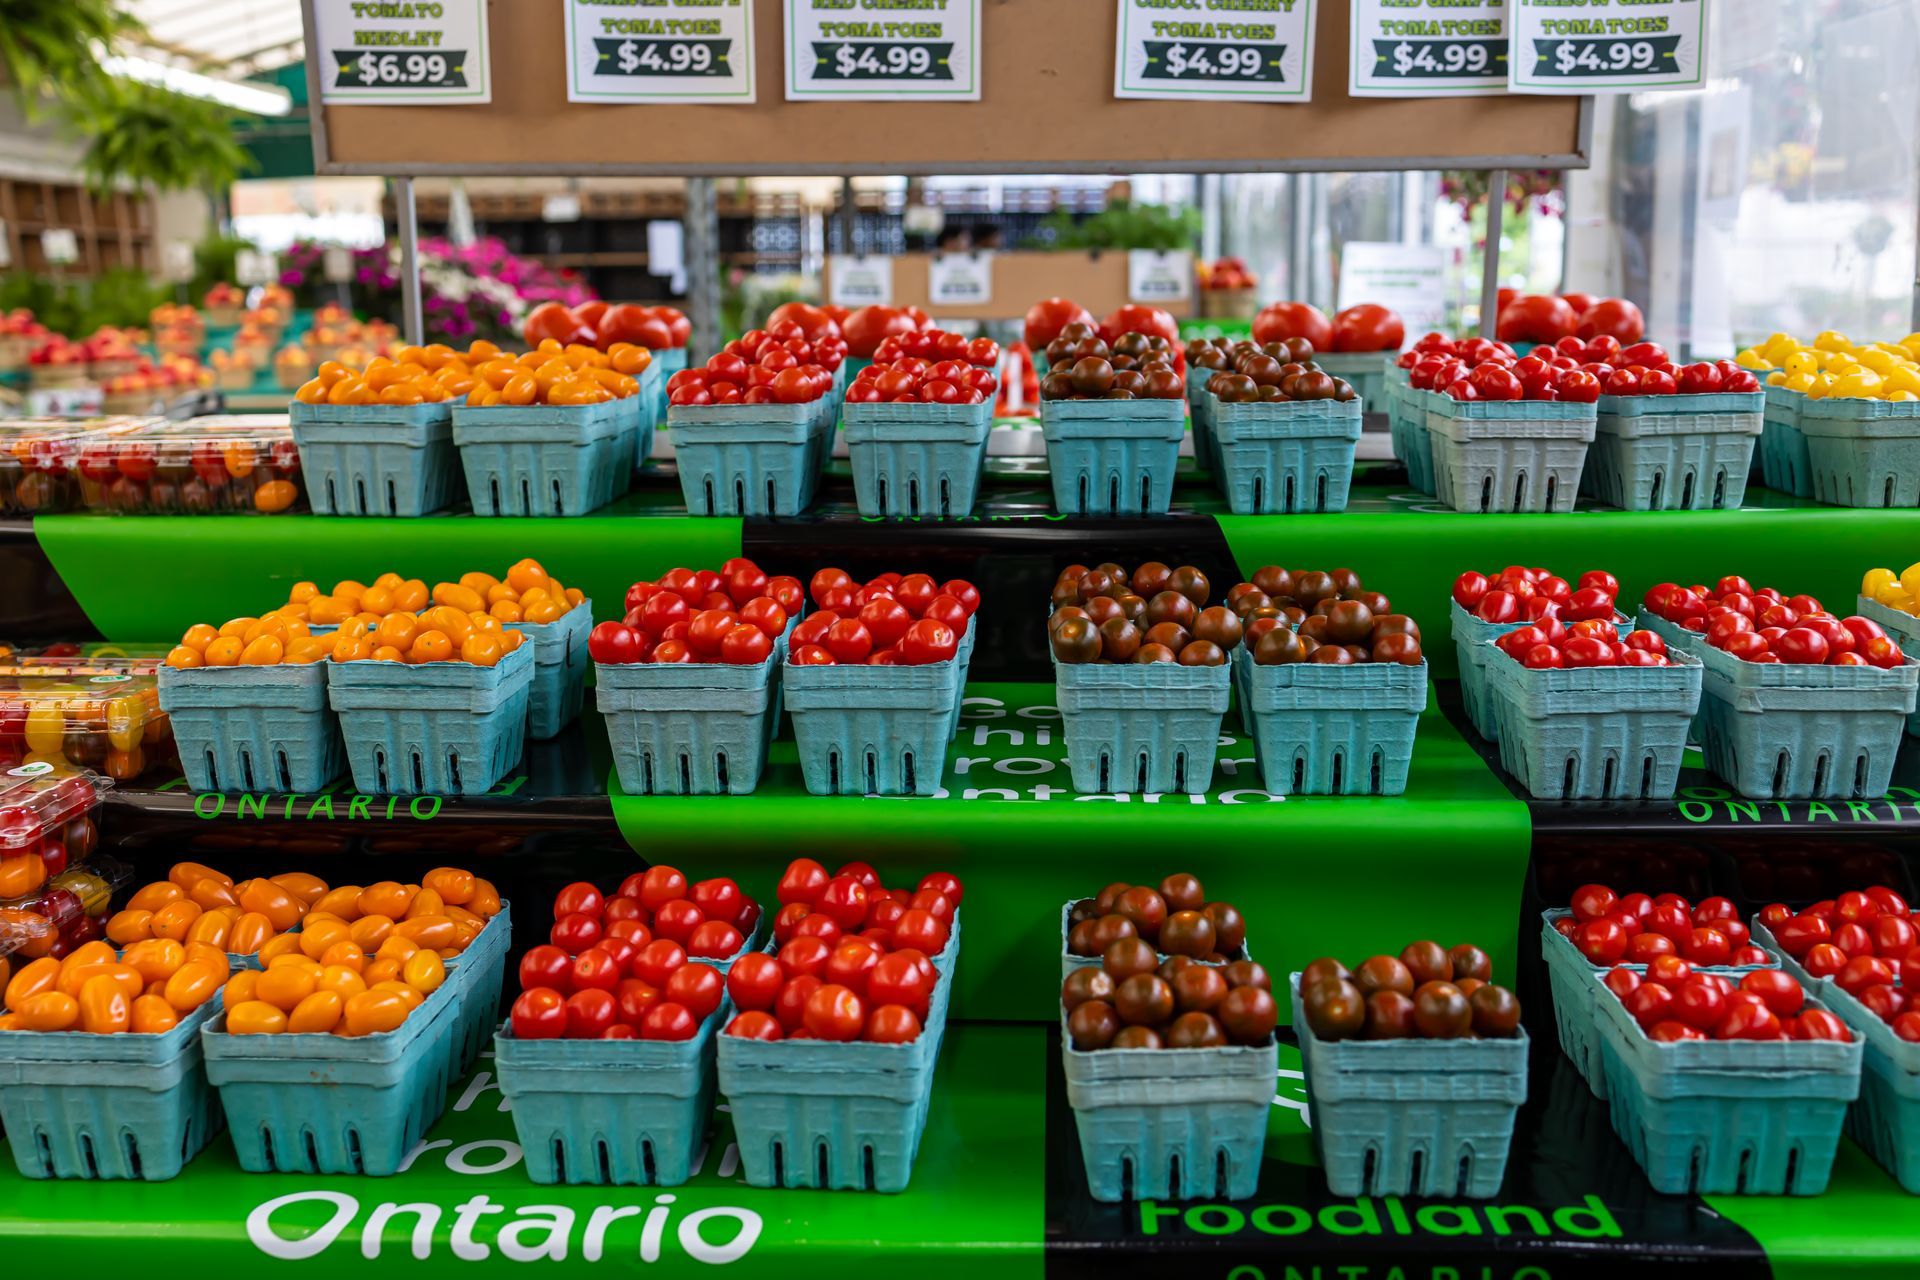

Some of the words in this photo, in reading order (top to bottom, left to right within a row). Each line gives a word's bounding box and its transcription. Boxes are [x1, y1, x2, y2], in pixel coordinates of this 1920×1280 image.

[351, 1, 443, 18] TOMATO
[354, 30, 443, 46] MEDLEY
[601, 18, 721, 35] TOMATOES
[819, 22, 942, 38] TOMATOES
[1152, 20, 1276, 40] TOMATOES
[1380, 19, 1503, 36] TOMATOES
[1541, 16, 1669, 35] TOMATOES
[357, 52, 447, 85] $6.99
[617, 40, 711, 74] $4.99
[834, 42, 931, 77] $4.99
[1164, 42, 1263, 78] $4.99
[1392, 41, 1489, 76] $4.99
[1554, 40, 1656, 75] $4.99
[194, 792, 443, 820] ONTARIO
[246, 1190, 763, 1264] Ontario
